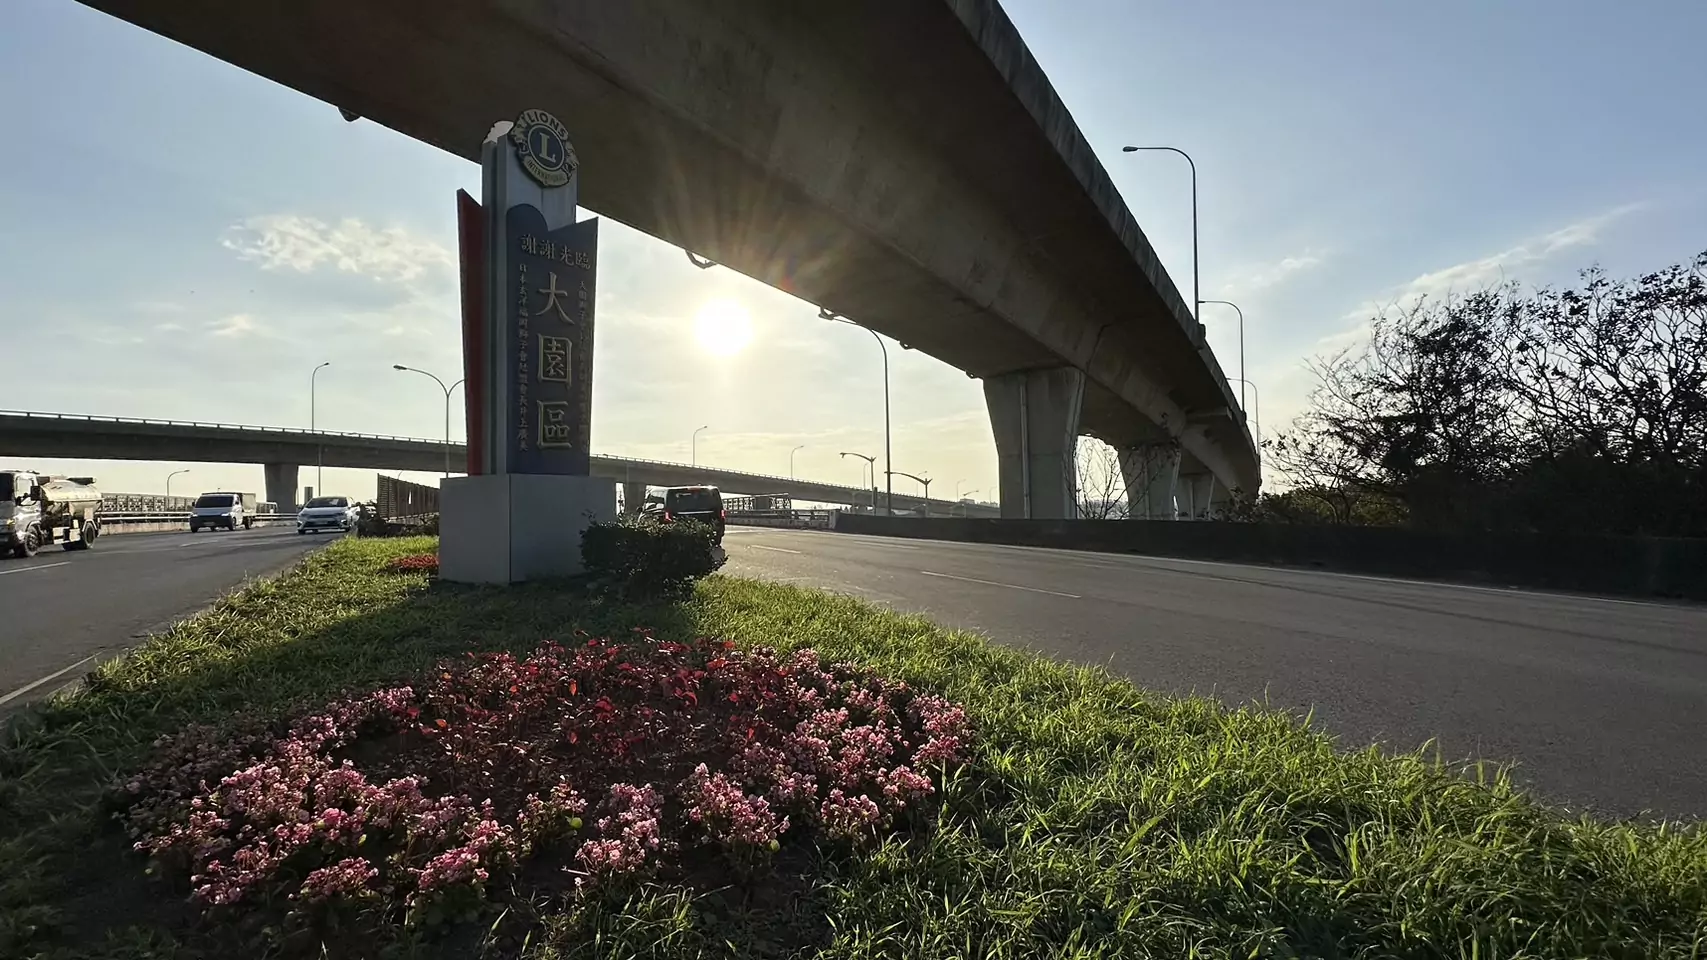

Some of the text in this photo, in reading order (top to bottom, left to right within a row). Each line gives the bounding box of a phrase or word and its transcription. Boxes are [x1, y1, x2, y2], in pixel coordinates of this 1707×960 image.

[527, 111, 567, 139] LIONS
[539, 132, 557, 163] L
[520, 233, 591, 270] 謝謝光臨
[536, 271, 575, 449] 大園區
